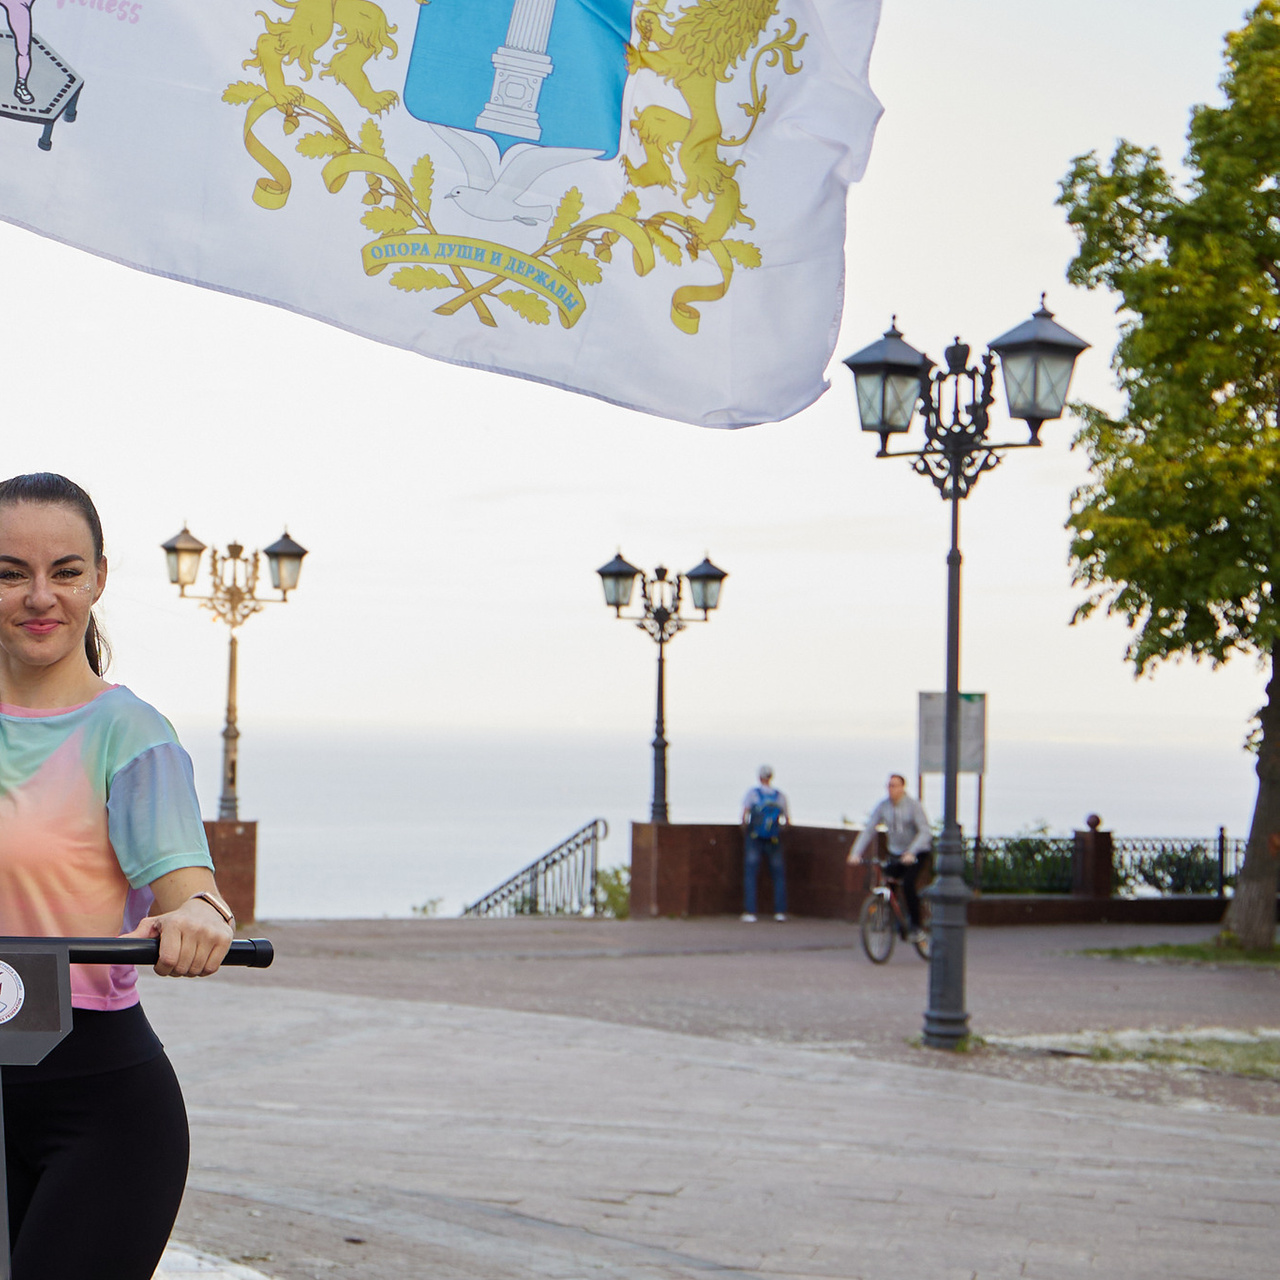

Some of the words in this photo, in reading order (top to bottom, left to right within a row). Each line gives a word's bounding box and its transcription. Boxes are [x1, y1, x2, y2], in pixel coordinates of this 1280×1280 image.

[370, 242, 431, 260] ОПОРА
[434, 242, 487, 264] ДУШИ
[489, 250, 504, 267] И
[504, 256, 580, 312] ДЕРЖАВЫ
